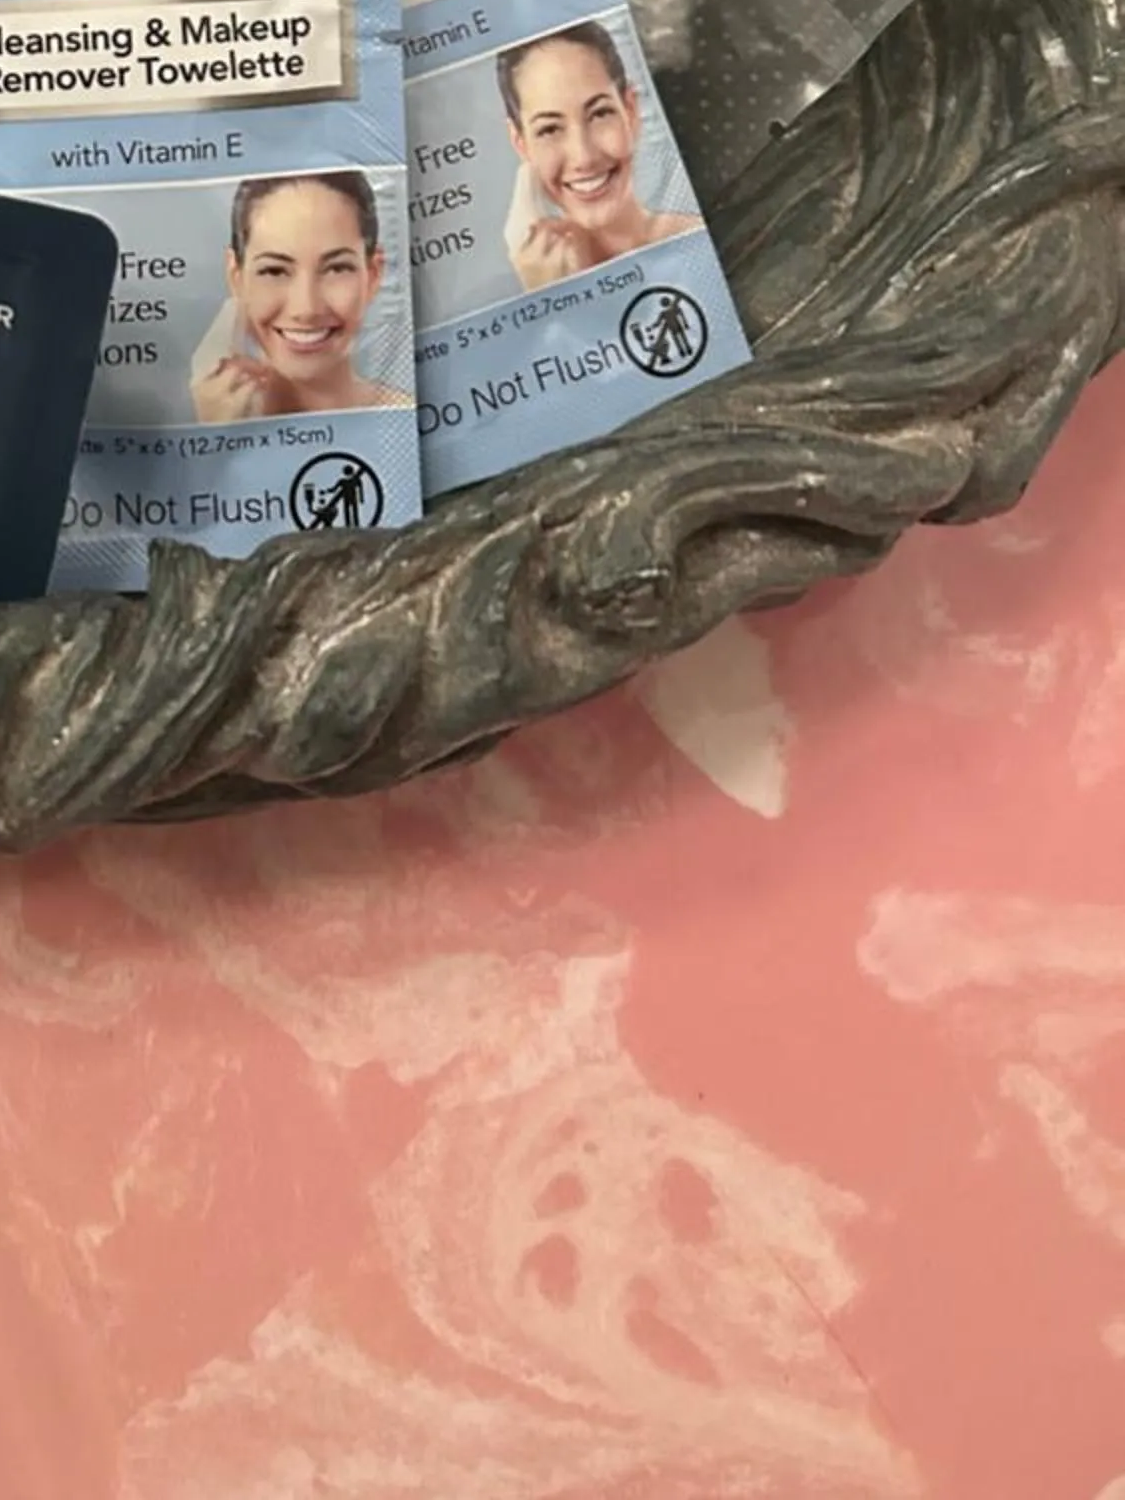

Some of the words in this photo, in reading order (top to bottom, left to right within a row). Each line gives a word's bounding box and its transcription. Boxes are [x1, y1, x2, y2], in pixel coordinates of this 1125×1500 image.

[145, 18, 170, 47] &
[180, 13, 311, 46] Makeup
[472, 9, 491, 35] E
[137, 51, 305, 85] Towelette
[51, 144, 109, 168] with
[115, 139, 218, 165] Vitamin
[227, 133, 244, 158] E
[414, 136, 477, 173] Free
[119, 251, 186, 280] Free
[512, 292, 580, 330] (12.7cm
[585, 288, 595, 300] x
[598, 264, 645, 295] 15cm)
[417, 402, 463, 436] Do
[469, 372, 530, 417] Not
[532, 339, 624, 392] Flush
[179, 434, 253, 458] (12.7cm
[259, 436, 271, 447] x
[277, 425, 333, 446] 15cm)
[115, 494, 184, 526] Not
[190, 489, 285, 524] Flush
